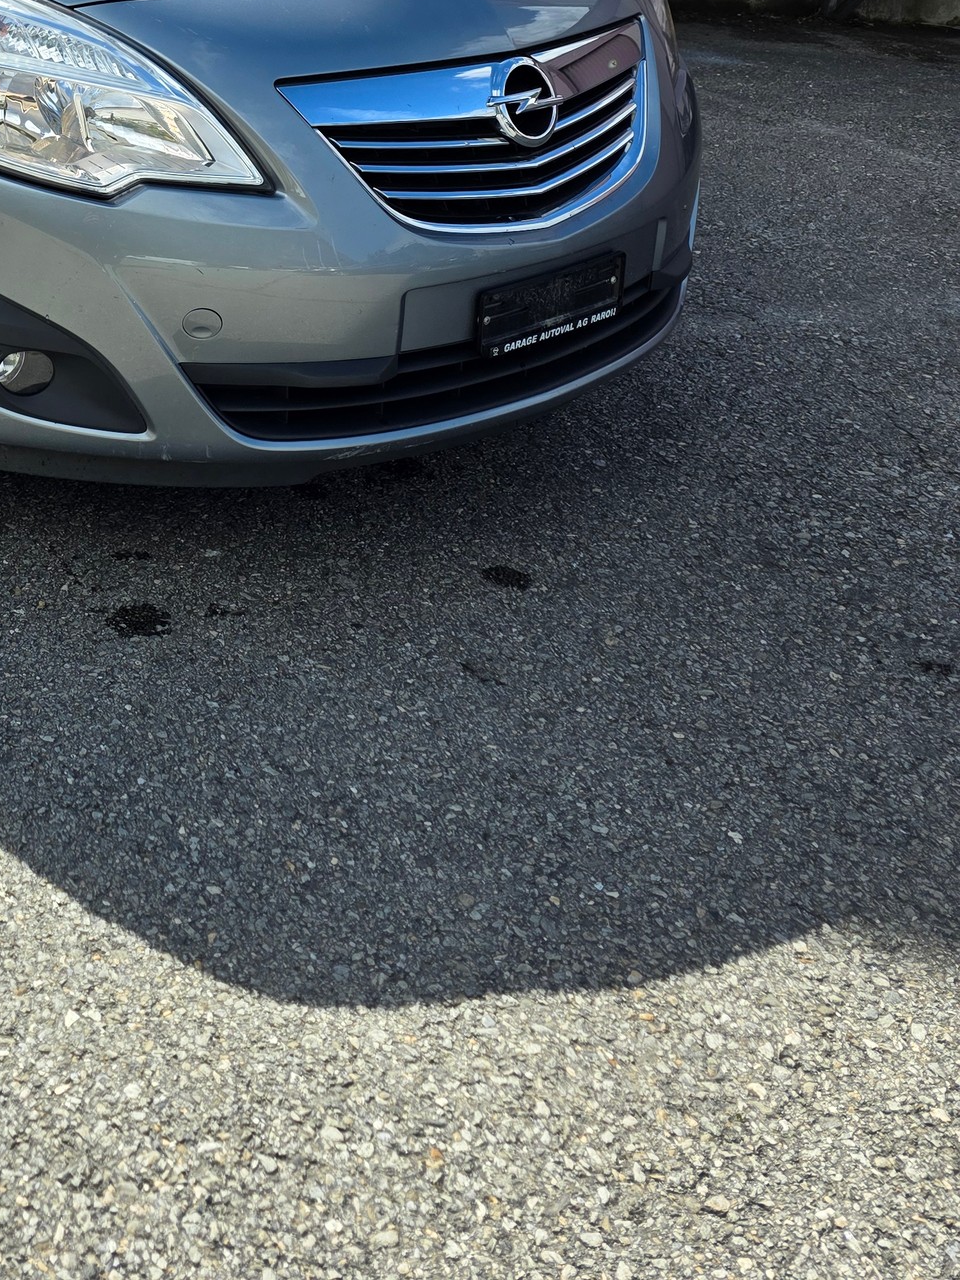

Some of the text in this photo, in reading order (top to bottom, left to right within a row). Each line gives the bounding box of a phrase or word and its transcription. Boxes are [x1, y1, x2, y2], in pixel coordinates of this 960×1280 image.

[504, 335, 537, 352] GARAGE
[539, 323, 574, 341] AUTOVAL
[576, 318, 588, 329] AG
